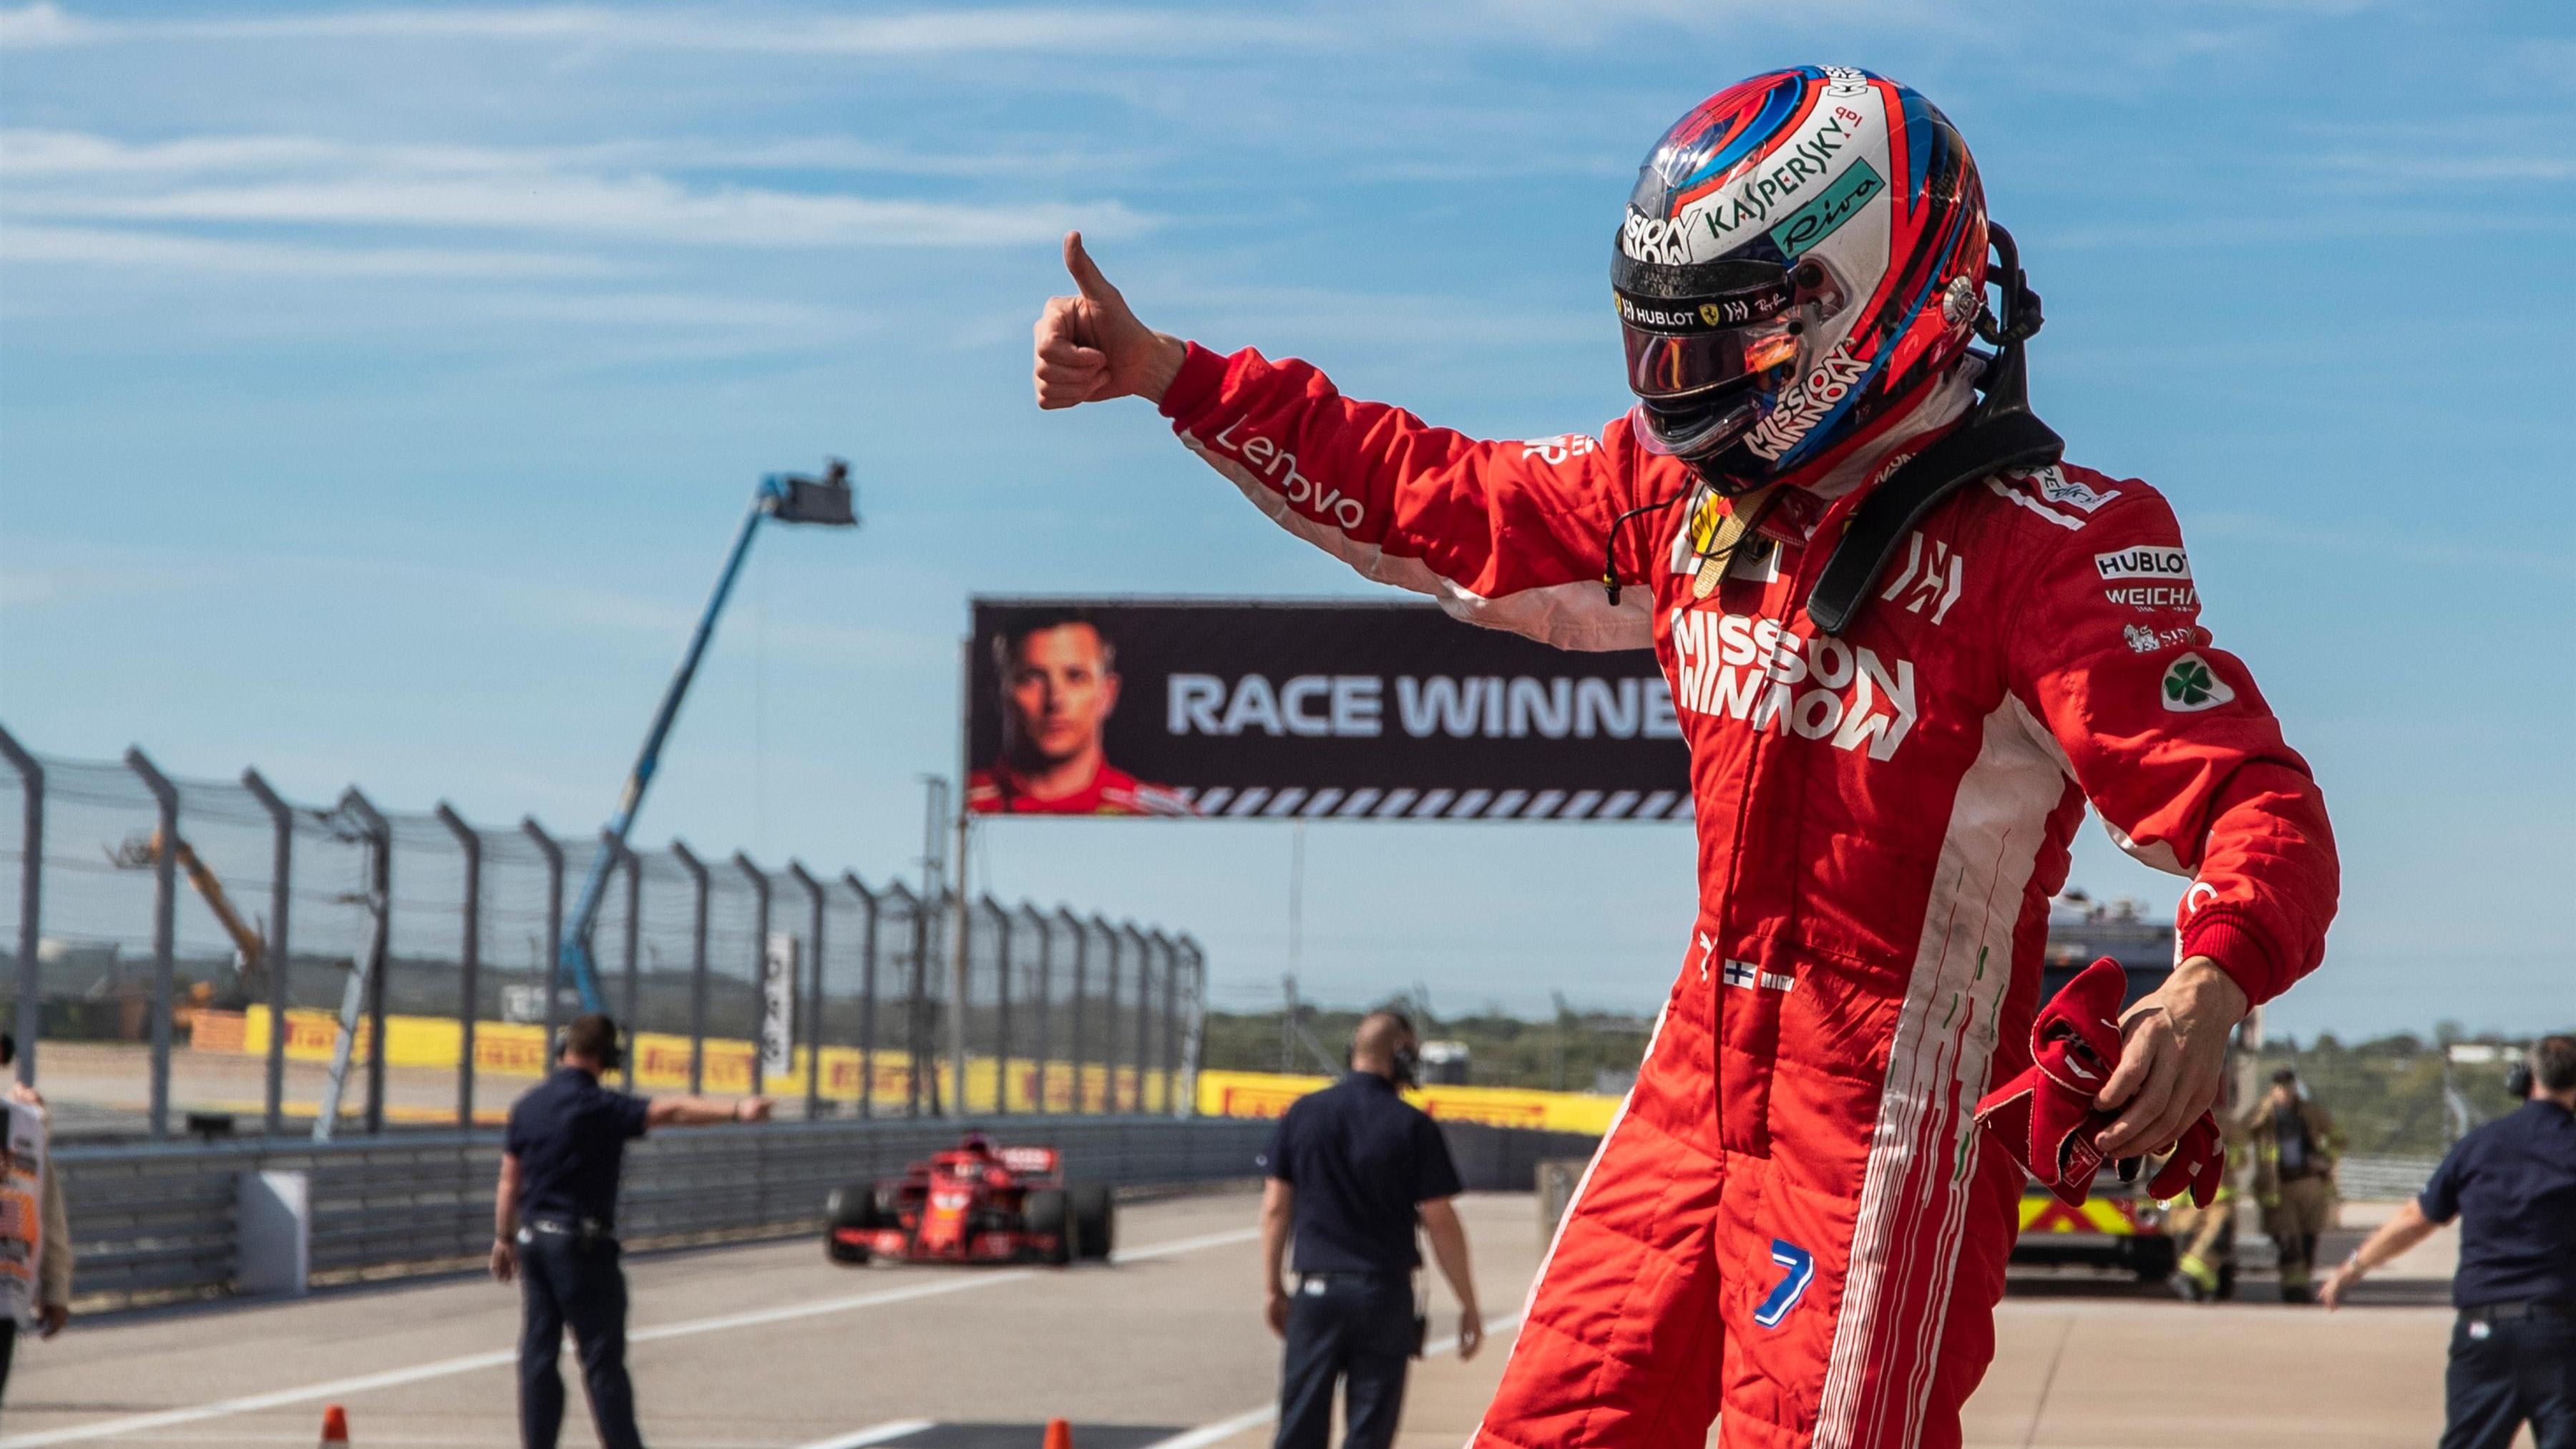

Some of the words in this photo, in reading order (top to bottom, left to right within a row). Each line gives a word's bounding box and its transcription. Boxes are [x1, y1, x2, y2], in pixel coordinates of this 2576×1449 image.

[1705, 116, 1843, 239] KASPERSKY
[1835, 106, 1863, 127] lab
[1782, 179, 1878, 253] Riva
[1636, 308, 1694, 326] HUBLOT
[1743, 343, 1853, 452] MISSION
[1752, 360, 1872, 462] WINNOW
[1216, 414, 1365, 530] Lenovo
[2098, 552, 2187, 575] HUBLO
[2106, 588, 2200, 605] WEICHA
[1167, 675, 1381, 736] RACE
[1396, 676, 1682, 739] WINNE
[1754, 1238, 1815, 1329] 7
